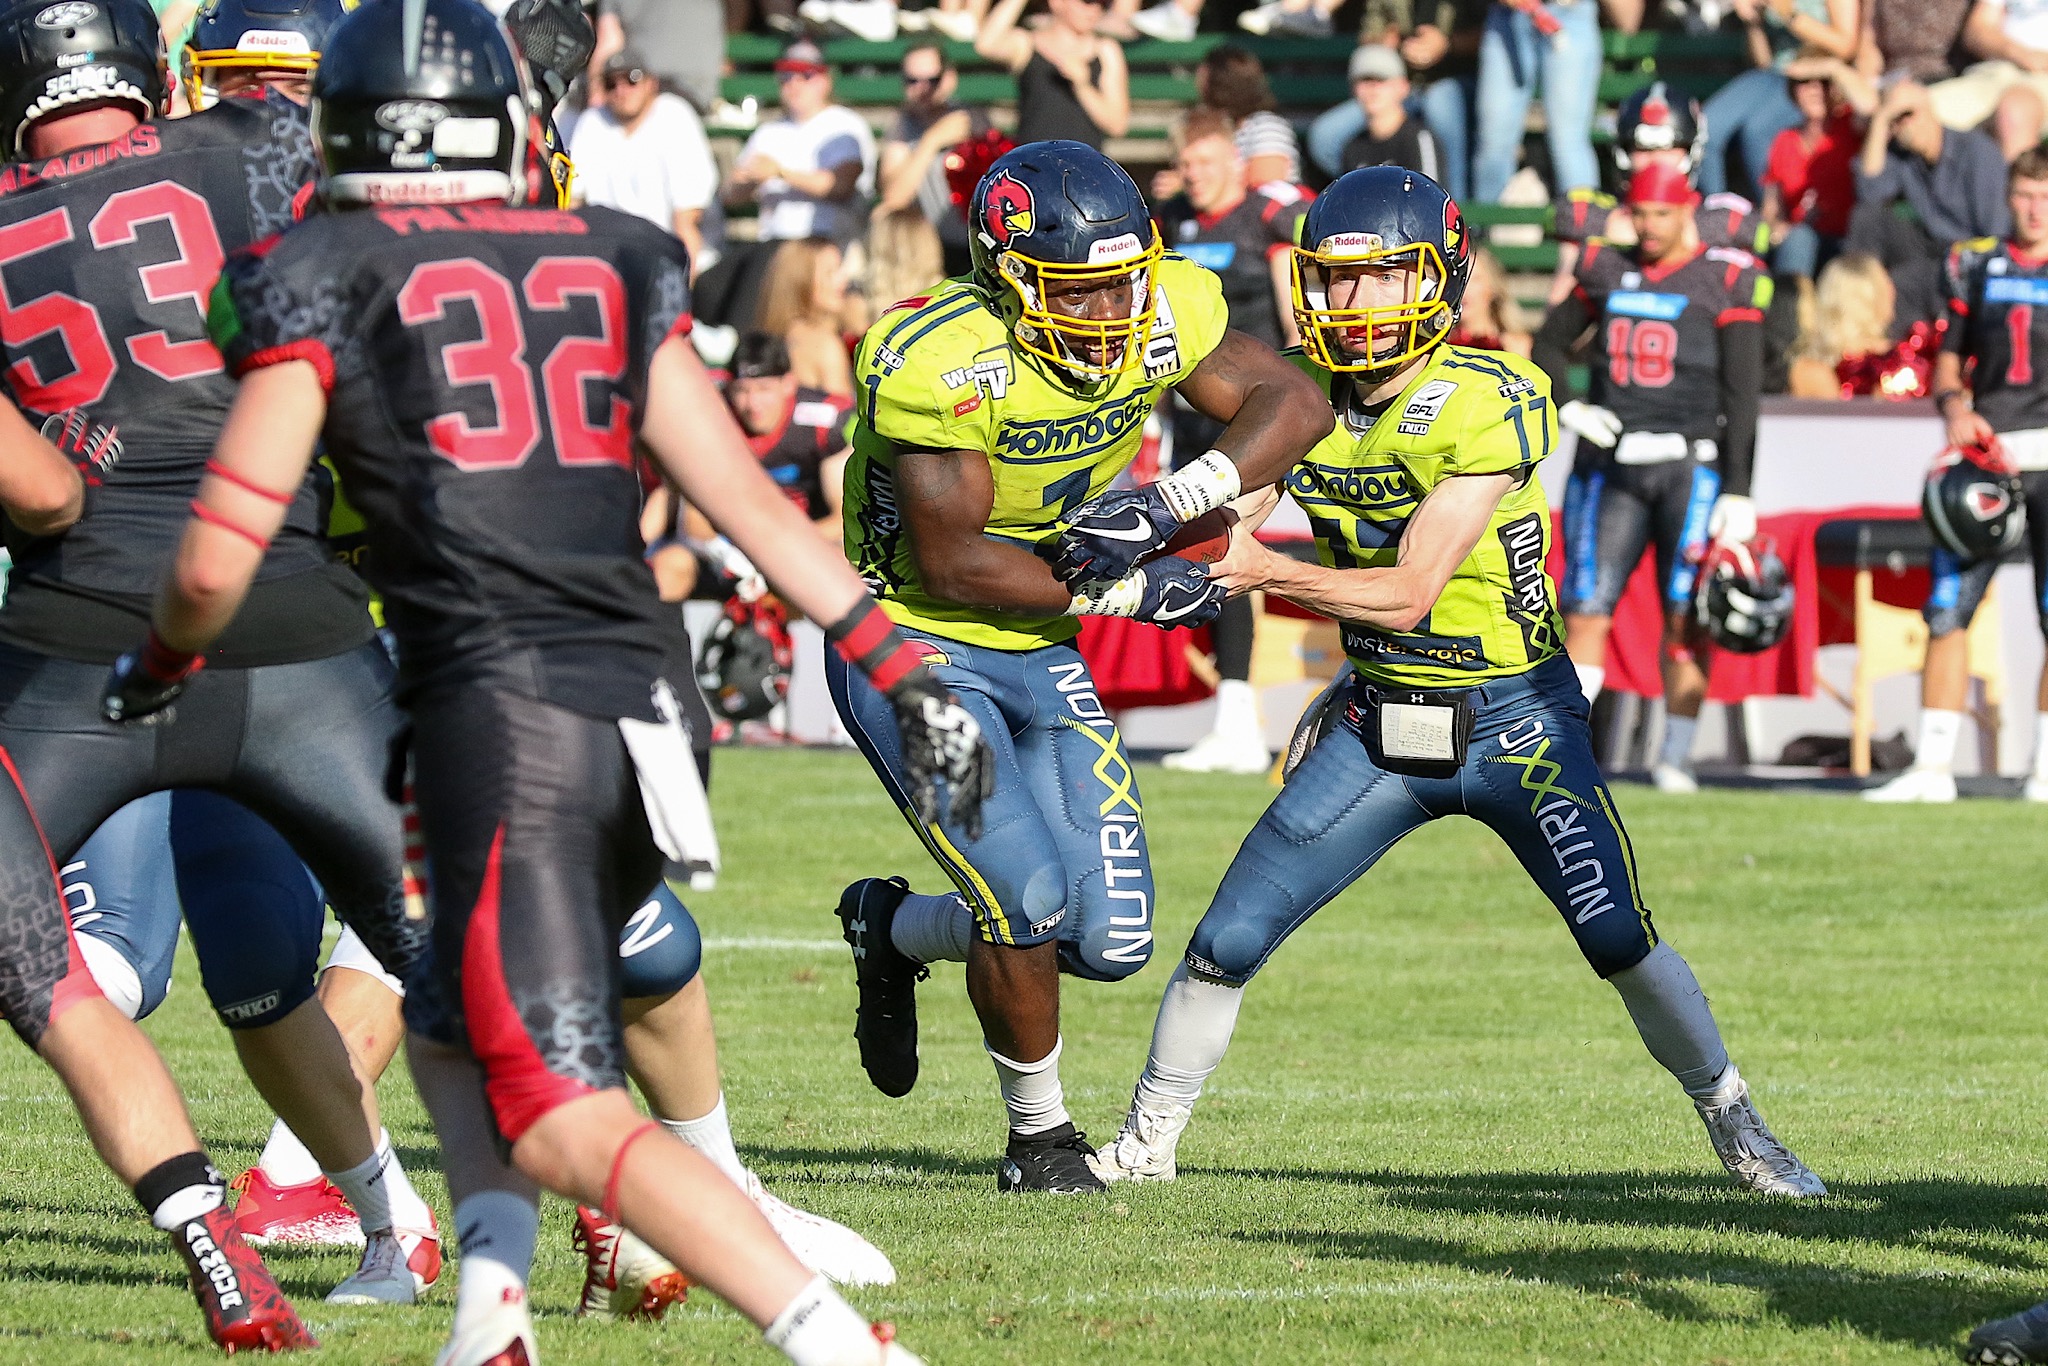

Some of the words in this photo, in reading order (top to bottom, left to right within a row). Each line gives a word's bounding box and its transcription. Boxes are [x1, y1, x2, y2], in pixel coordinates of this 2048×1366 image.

[1098, 239, 1137, 254] Riddell
[1333, 234, 1369, 248] Riddell
[0, 179, 226, 416] 53
[396, 256, 634, 474] 32
[1606, 317, 1678, 388] 18
[2005, 304, 2033, 385] 1
[865, 374, 882, 432] 1
[1499, 379, 1533, 397] TNKD
[1398, 422, 1428, 435] TNKD
[1503, 396, 1550, 461] 17
[185, 1221, 244, 1311] ARMOUR
